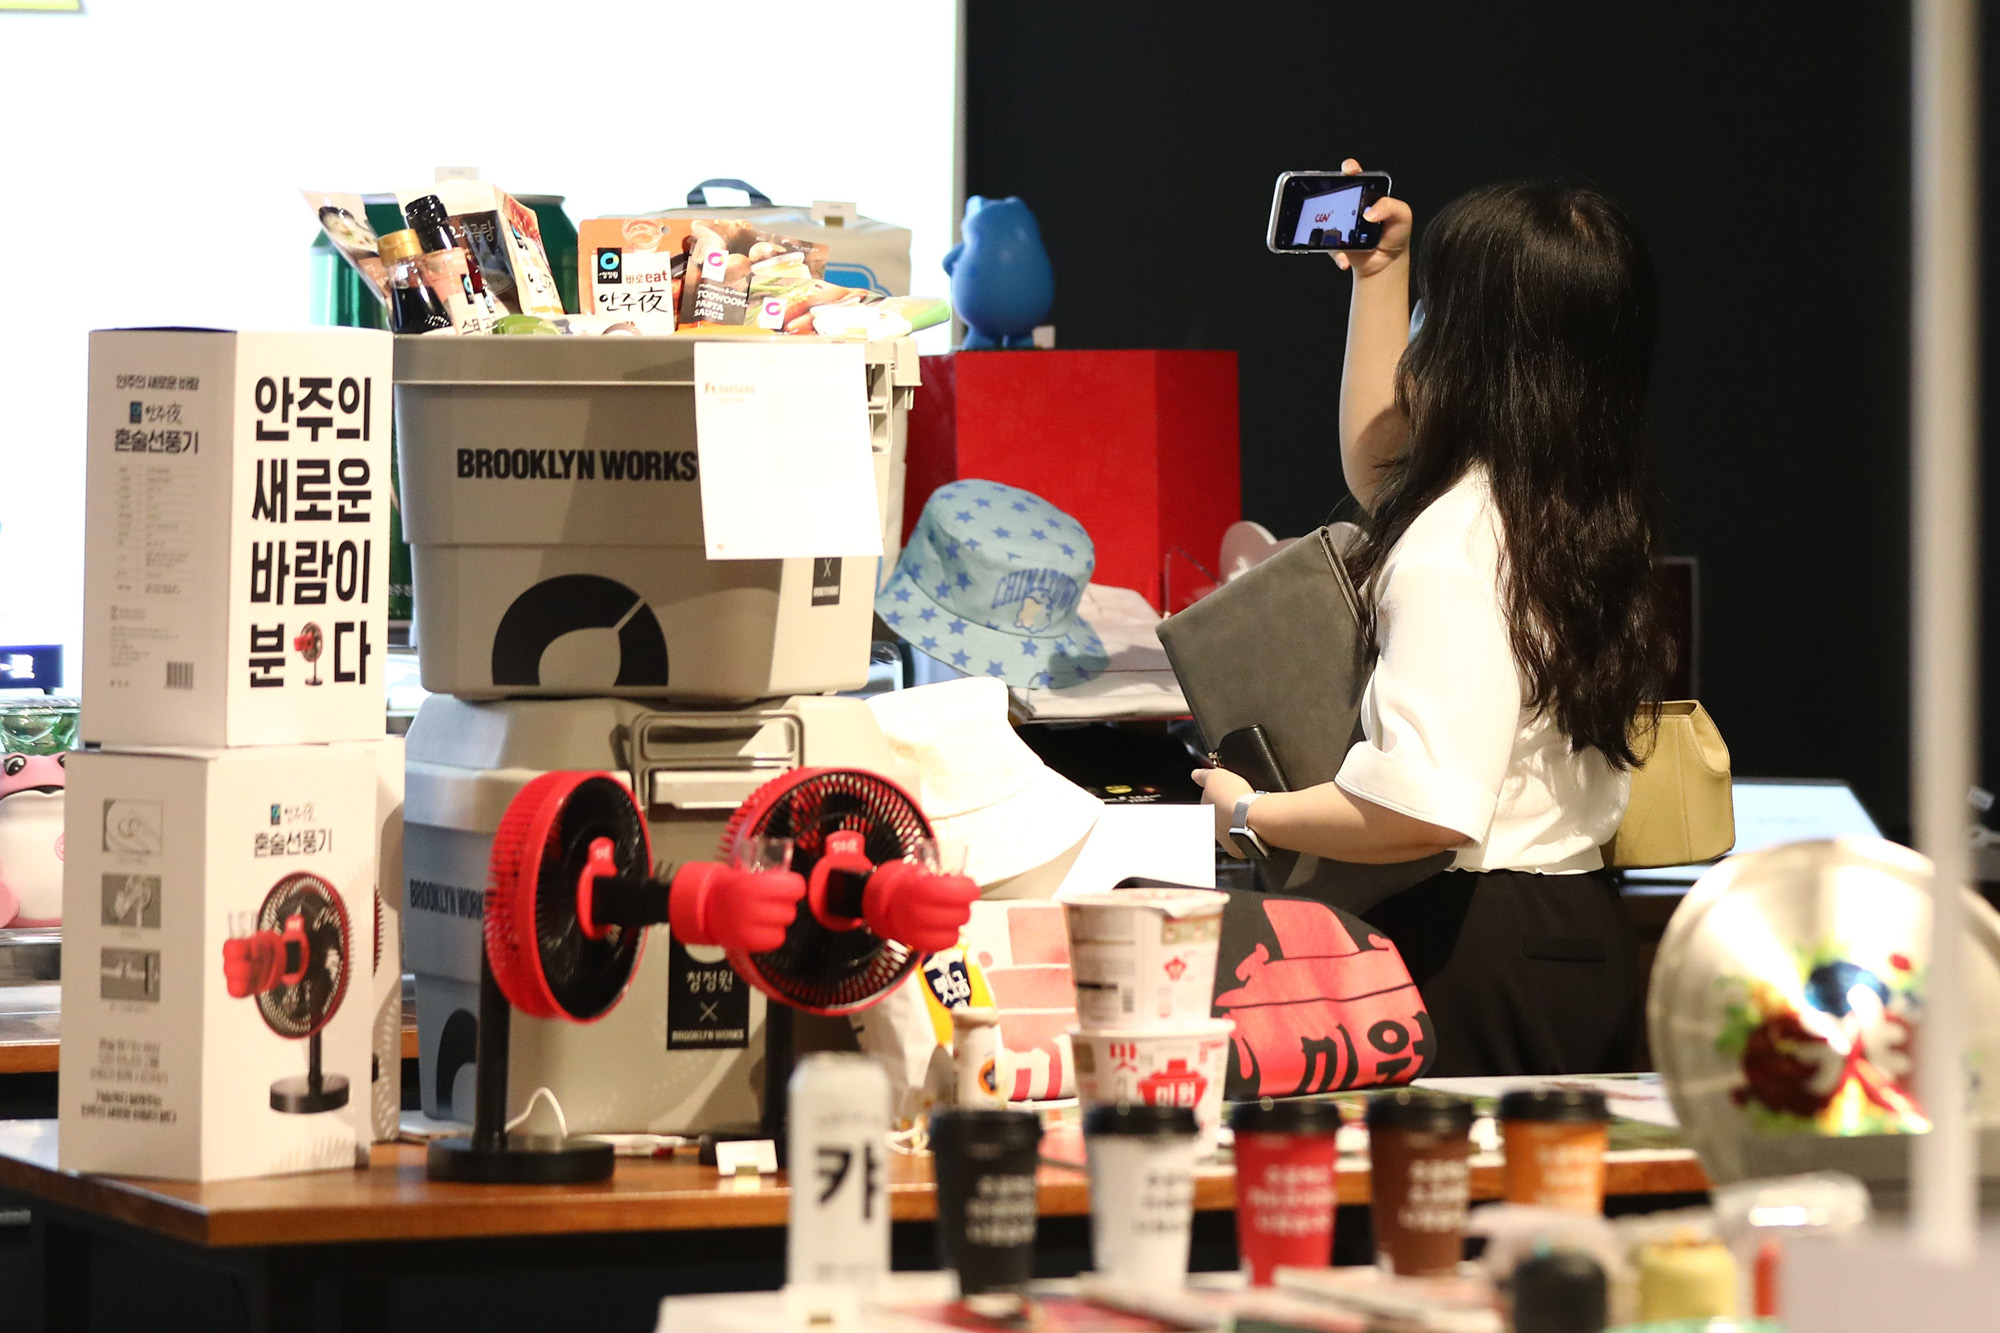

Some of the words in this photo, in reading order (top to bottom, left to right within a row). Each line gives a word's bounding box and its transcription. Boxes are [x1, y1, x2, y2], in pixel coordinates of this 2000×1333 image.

[599, 286, 668, 313] 안주夜
[695, 299, 724, 312] PASTA
[693, 308, 725, 321] SAUCE
[254, 376, 372, 442] 안주의
[115, 428, 199, 455] 혼술선풍기
[456, 448, 595, 480] BROOKLYN
[601, 449, 698, 482] WORKS
[251, 457, 372, 523] 새로운
[250, 539, 371, 606] 바람이
[254, 827, 332, 858] 혼술선풍기
[686, 969, 733, 993] 청정원
[671, 1029, 714, 1043] BROOKLYN
[715, 1028, 745, 1041] WORKS
